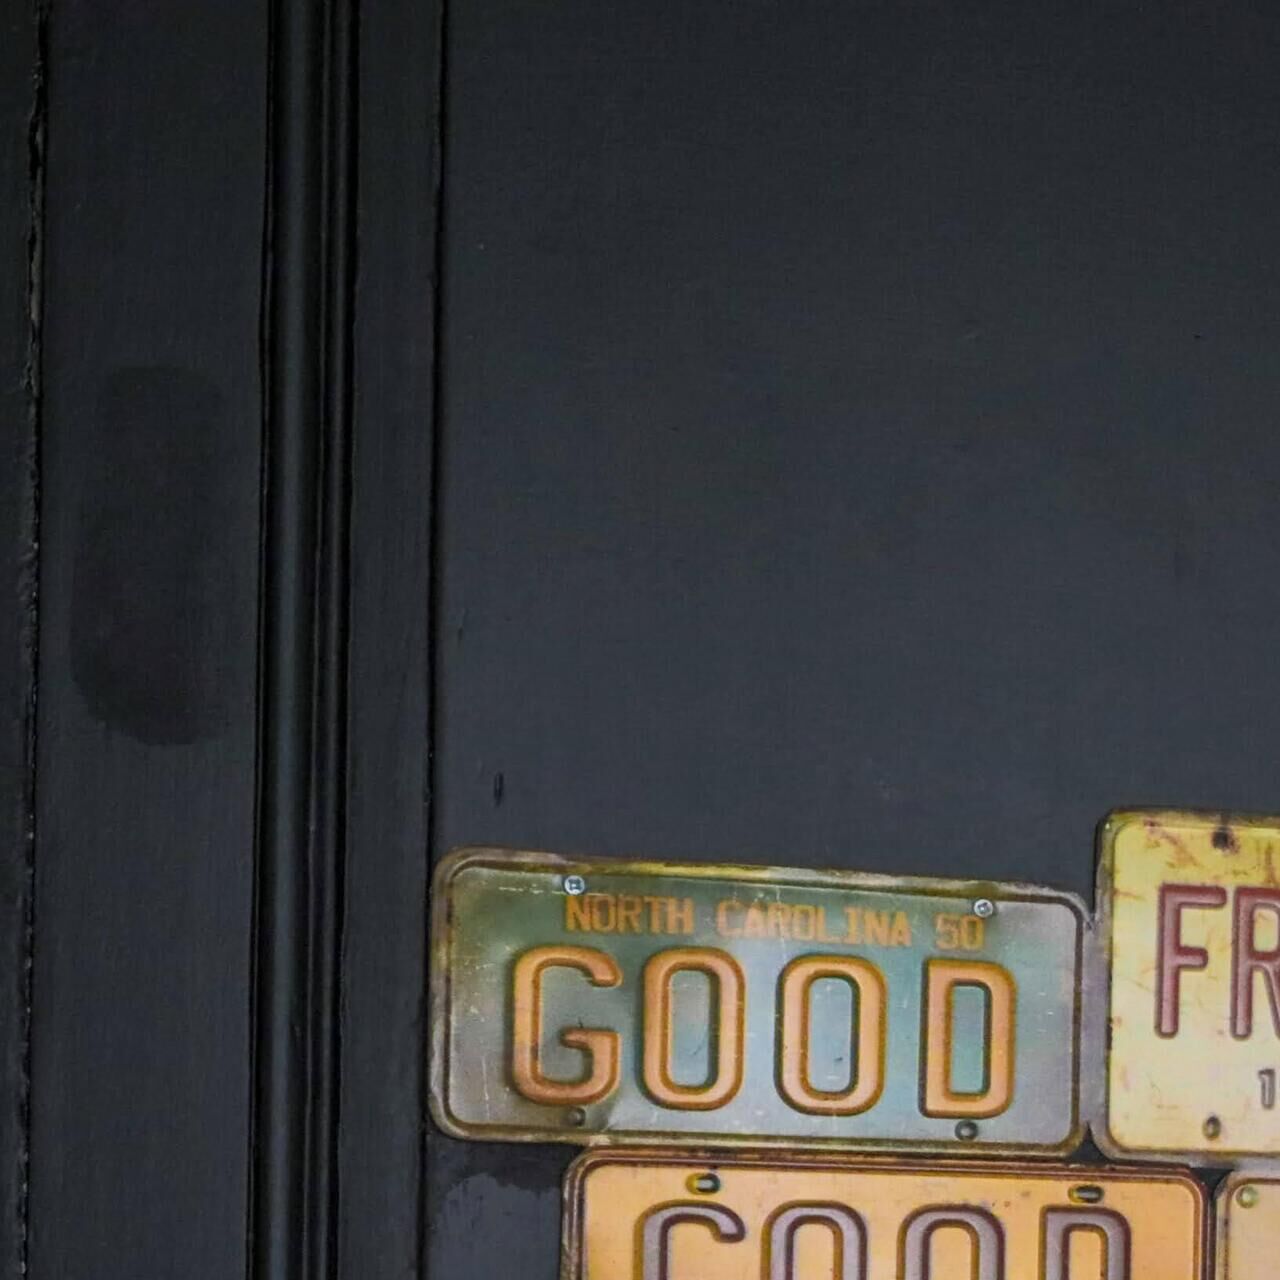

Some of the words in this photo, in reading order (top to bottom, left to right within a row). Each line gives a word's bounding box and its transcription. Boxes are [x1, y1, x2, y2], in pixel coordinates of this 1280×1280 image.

[566, 896, 694, 935] NORTH
[716, 900, 912, 946] CAROLINA
[934, 913, 986, 951] 50
[512, 945, 1017, 1118] GOOD
